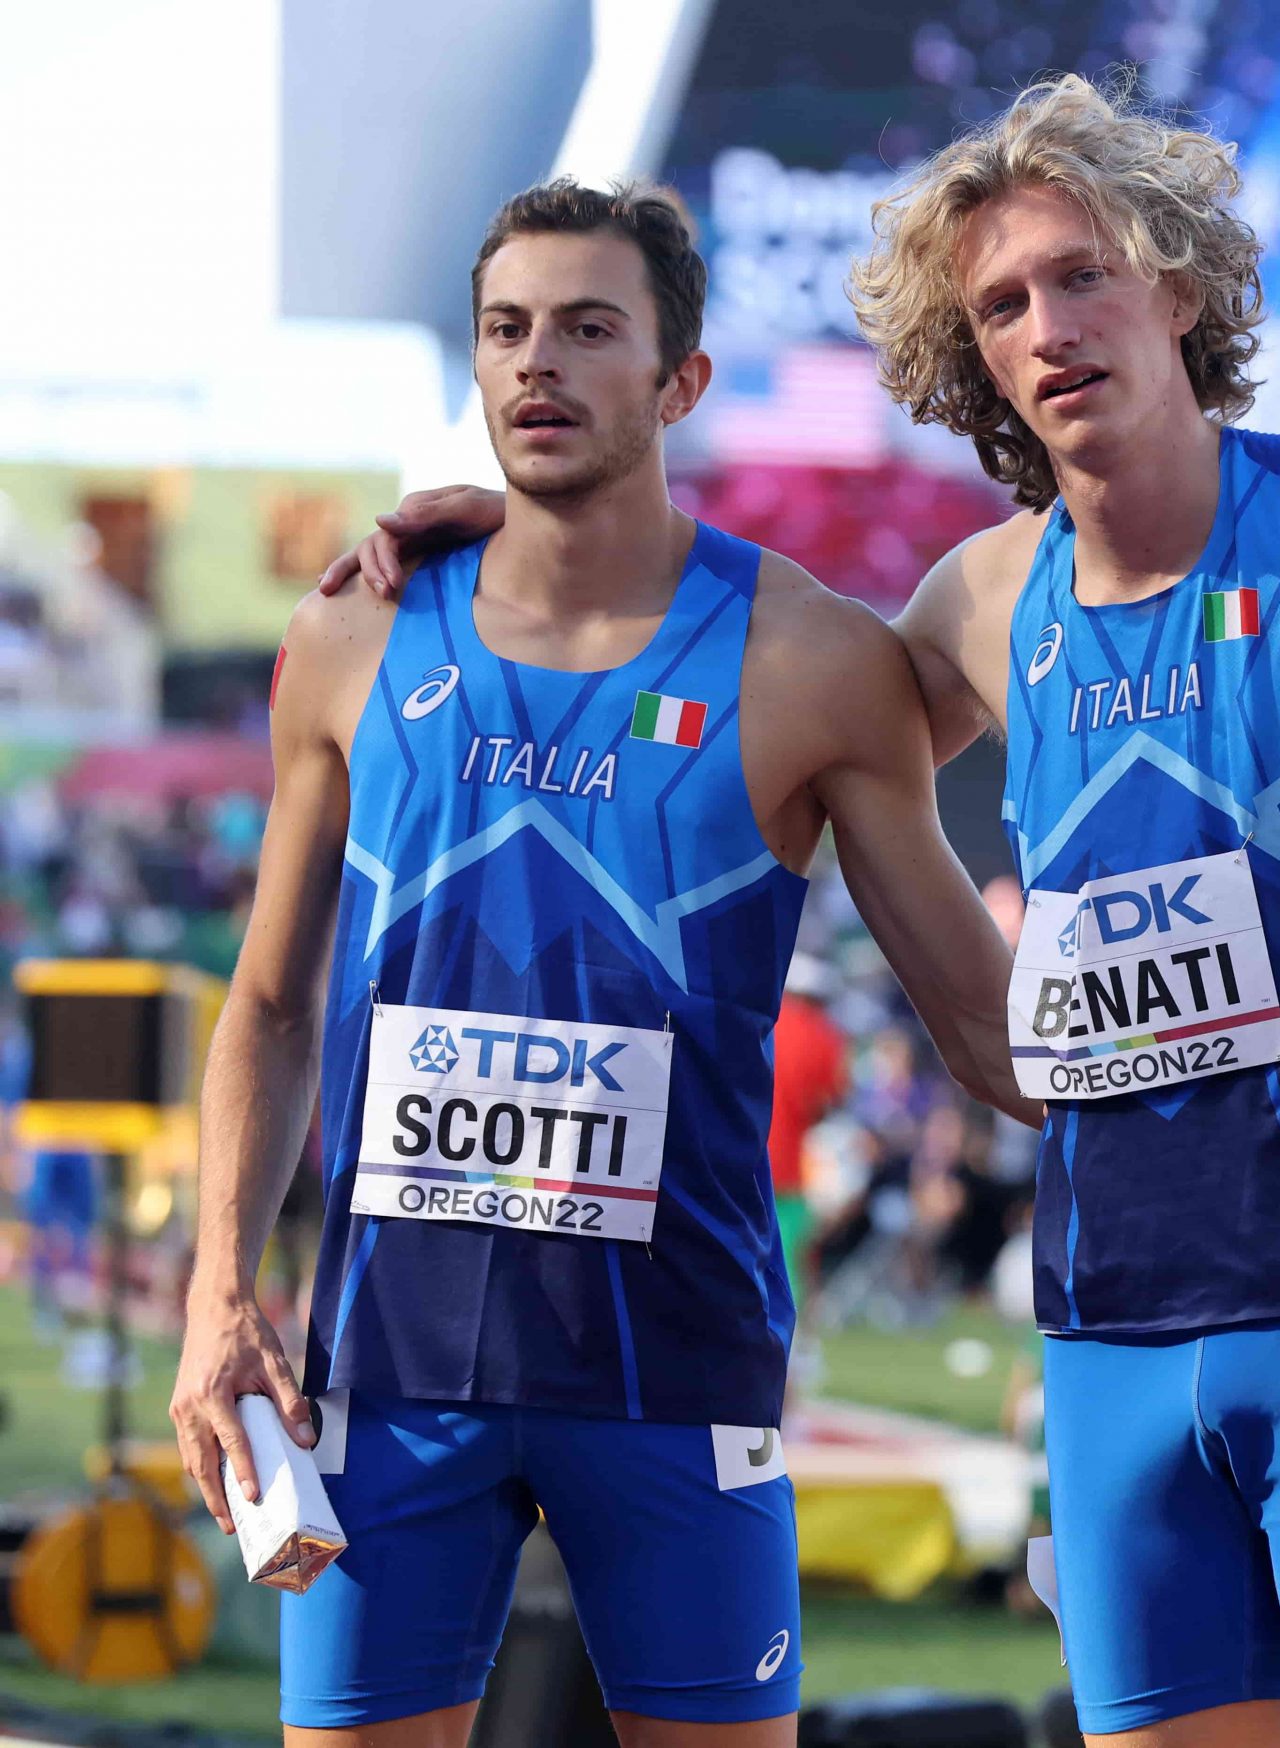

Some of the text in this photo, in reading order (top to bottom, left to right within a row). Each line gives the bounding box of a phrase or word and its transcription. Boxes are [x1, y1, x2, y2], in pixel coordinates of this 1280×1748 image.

[1070, 662, 1202, 733] ITALIA
[462, 736, 616, 799] ITALIA
[461, 1027, 629, 1092] TDK
[1050, 1036, 1239, 1094] OREGON22
[392, 1094, 628, 1177] SCOTTI
[399, 1184, 605, 1232] OREGON22
